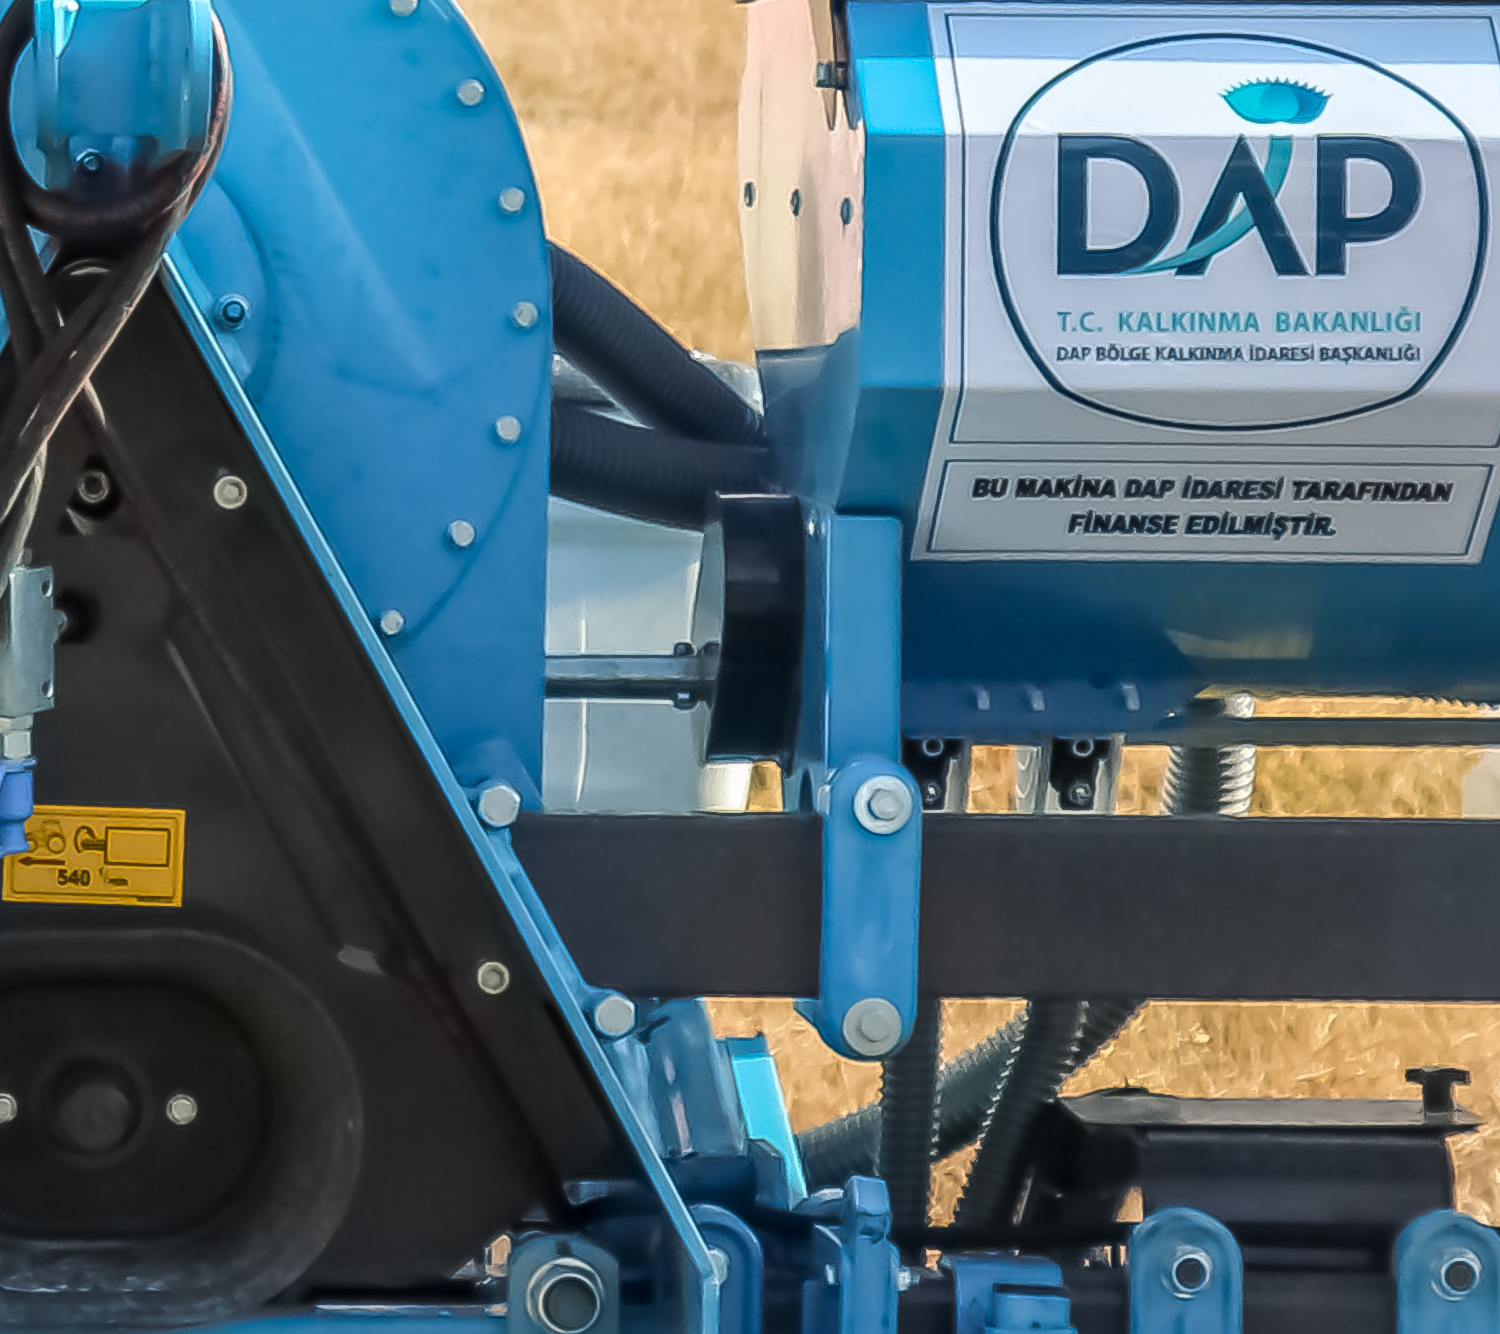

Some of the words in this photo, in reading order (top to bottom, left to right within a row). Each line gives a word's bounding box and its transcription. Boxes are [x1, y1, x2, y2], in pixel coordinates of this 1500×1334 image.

[1056, 133, 1425, 276] DAP
[1056, 311, 1103, 332] T.C.
[1118, 311, 1260, 332] KALKINMA
[1275, 306, 1422, 332] BAKANLIĞI
[1056, 346, 1092, 361] DAP
[1096, 342, 1151, 361] BÖLGE
[1155, 346, 1247, 361] KALKINMA
[1319, 343, 1421, 365] BAŞKANLIĞI
[971, 478, 1009, 498] BU
[1014, 474, 1117, 498] MAKİNA
[1123, 478, 1175, 498] DAP
[1181, 474, 1285, 500] İDARESİ
[1292, 480, 1454, 502] TARAFINDAN
[1067, 510, 1181, 534] FİNANSE
